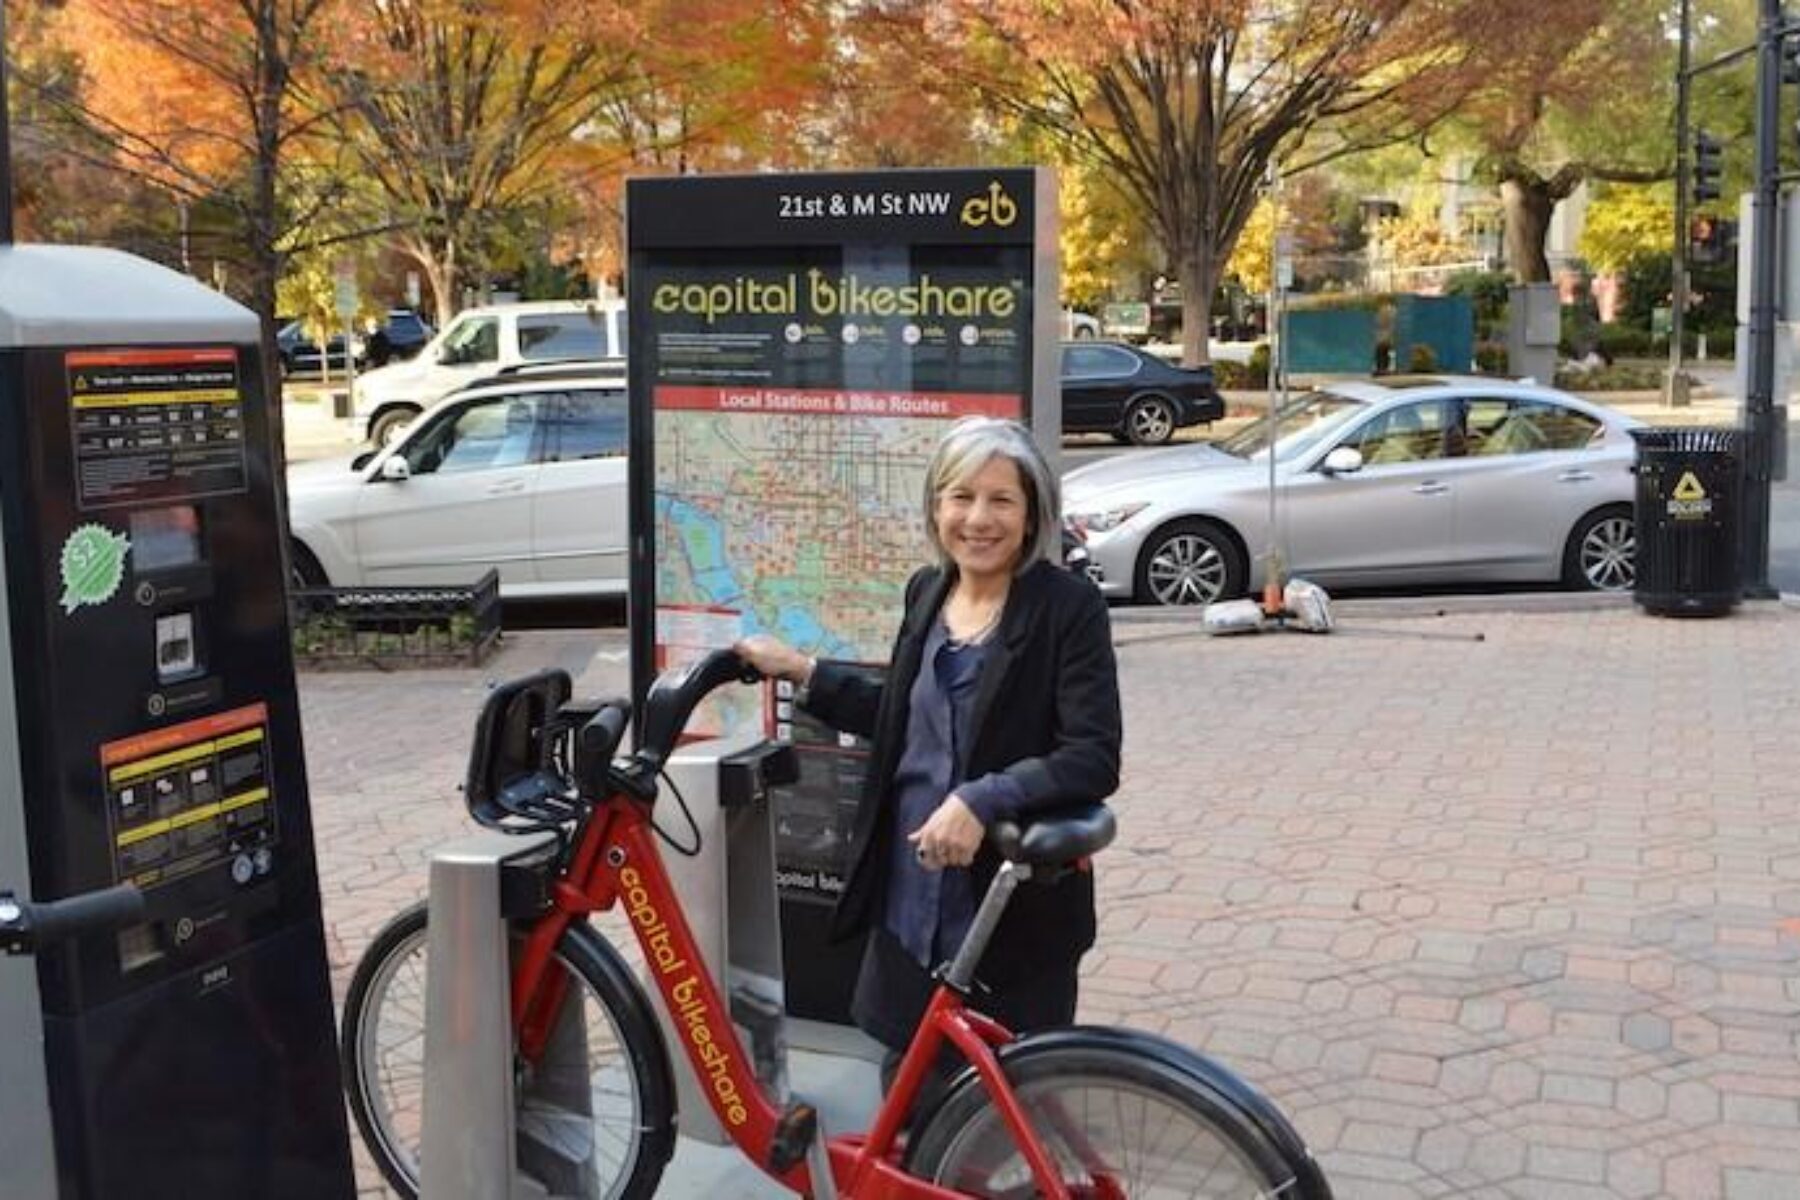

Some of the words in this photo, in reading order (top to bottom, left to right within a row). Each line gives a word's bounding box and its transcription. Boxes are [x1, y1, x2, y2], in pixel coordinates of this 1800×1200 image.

[780, 196, 824, 217] 21st
[829, 194, 847, 216] &
[853, 193, 875, 215] M
[880, 192, 903, 215] St
[908, 192, 950, 214] NW
[654, 274, 797, 322] capital
[808, 268, 1015, 317] bikeshare
[719, 391, 763, 408] Local
[766, 392, 832, 411] Stations
[834, 395, 846, 411] &
[850, 395, 885, 412] Bike
[889, 396, 949, 414] Routes
[620, 867, 687, 975] capital
[673, 977, 748, 1126] bikeshare
